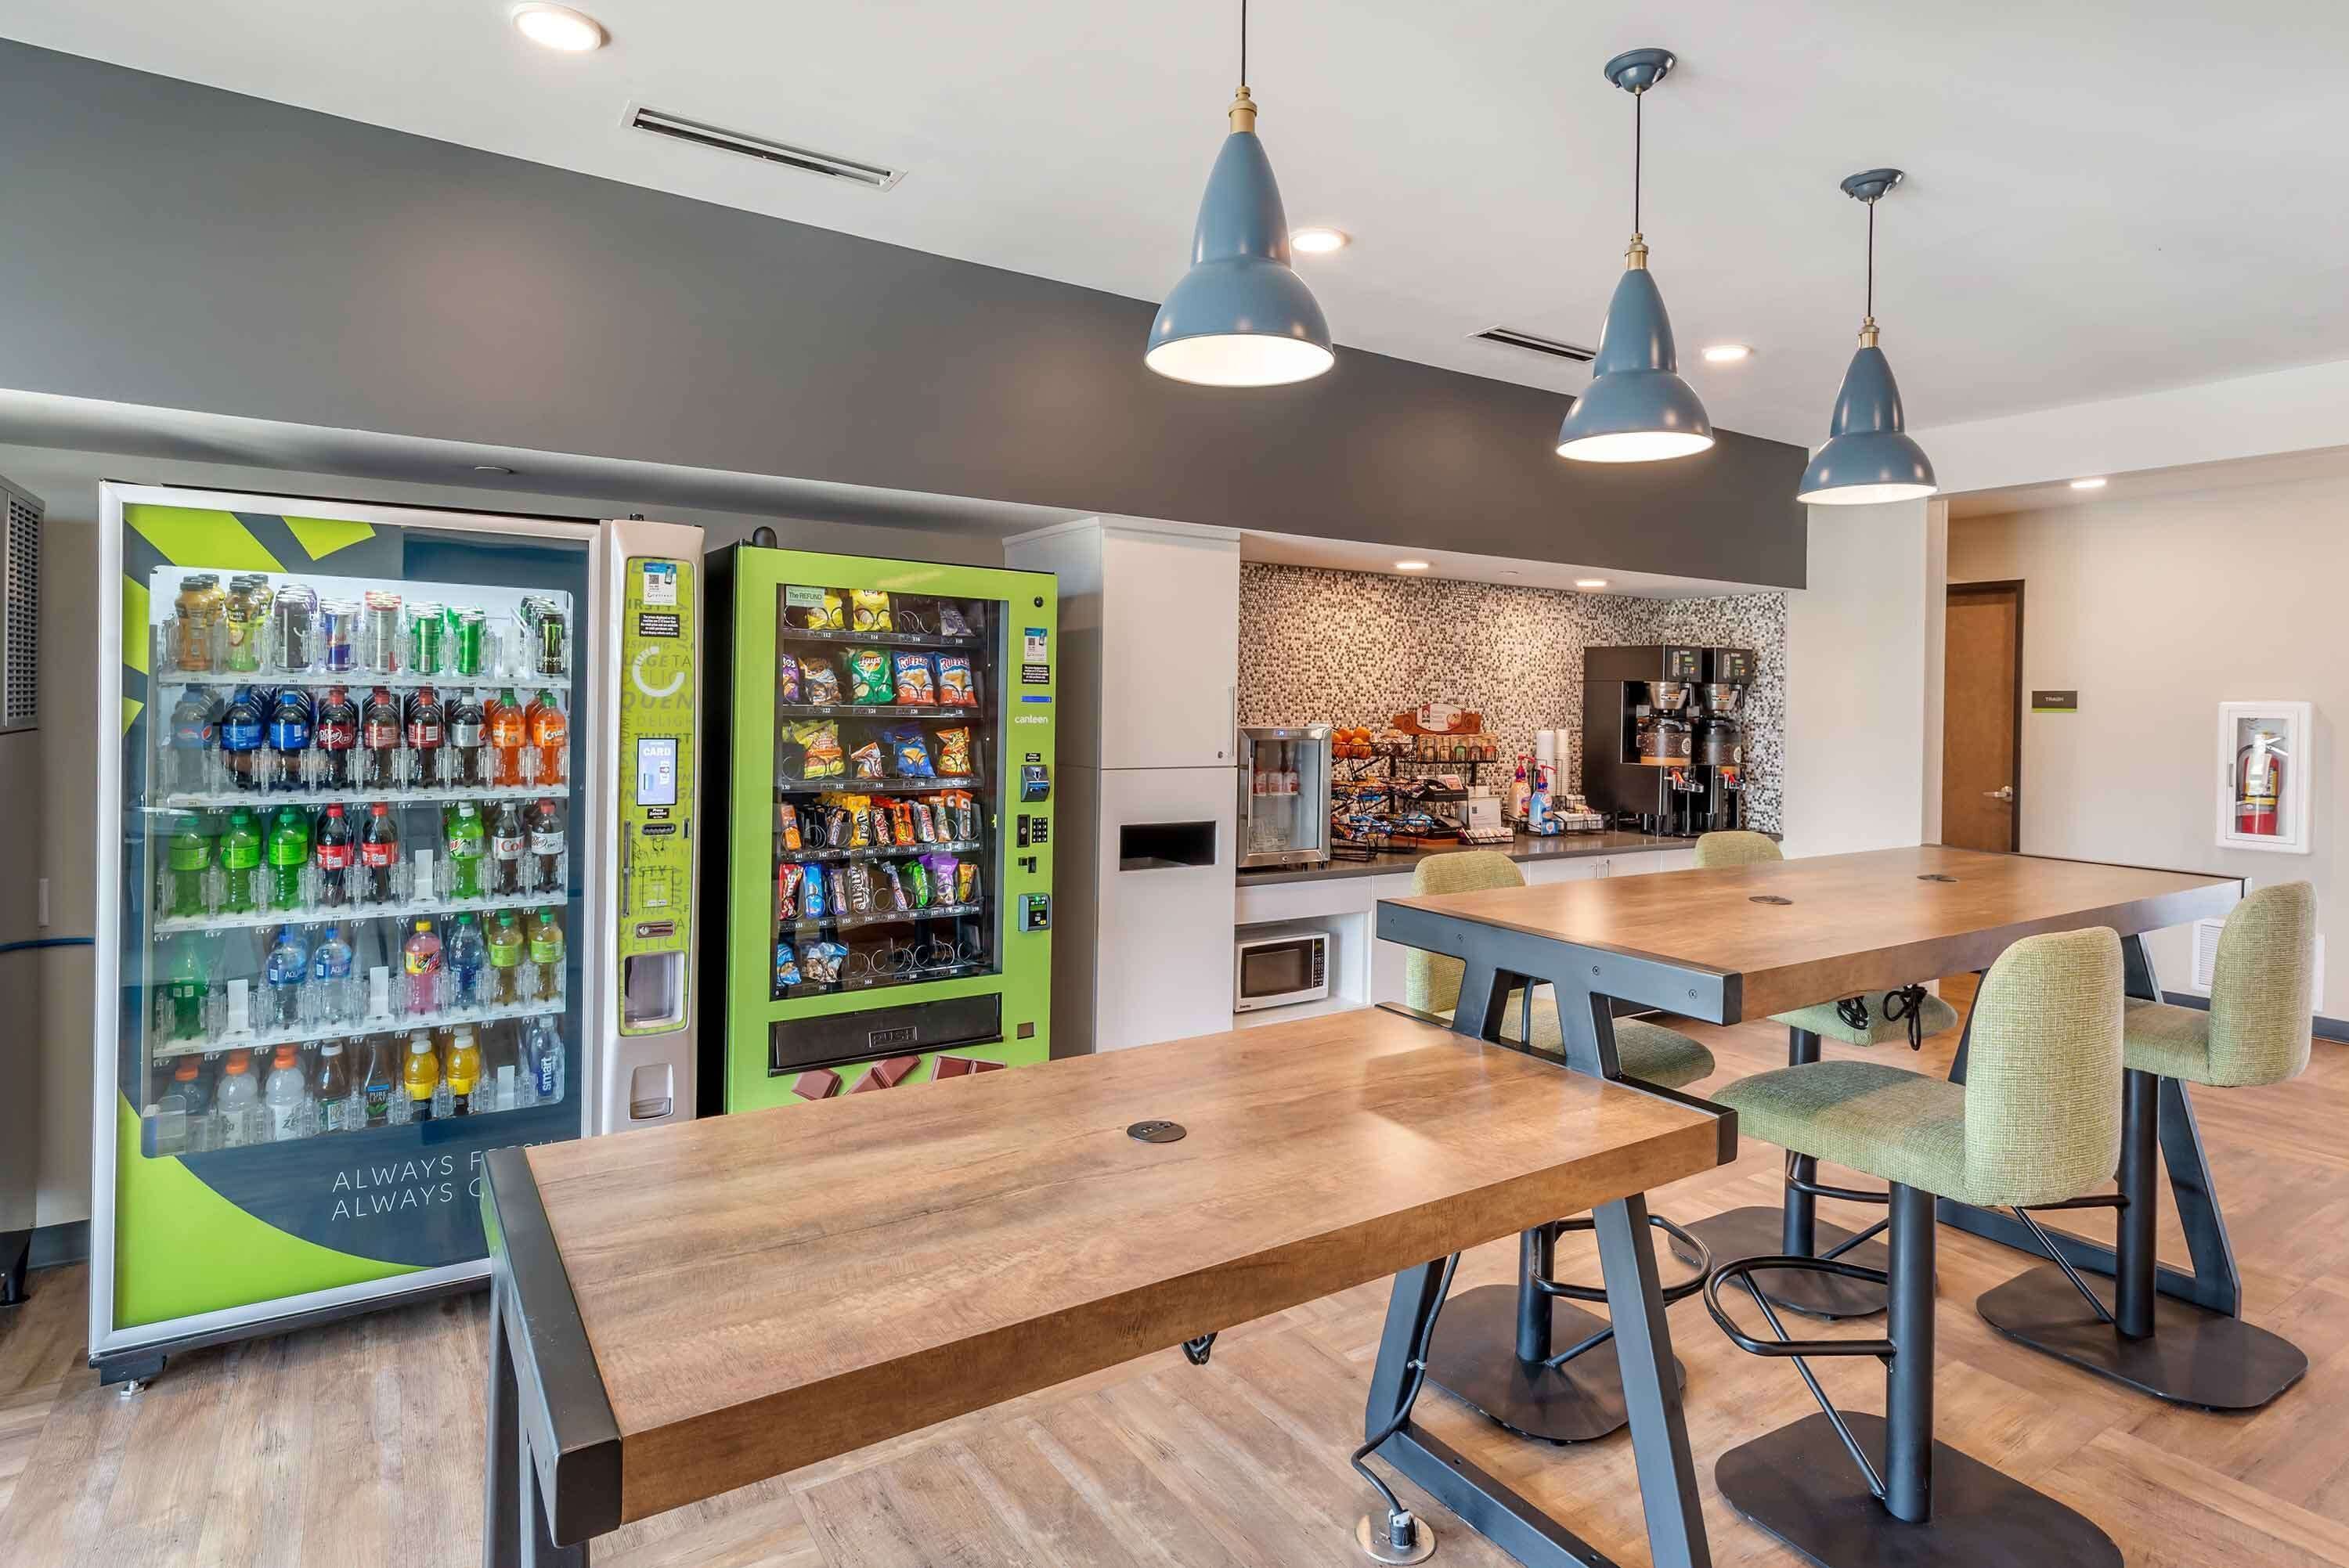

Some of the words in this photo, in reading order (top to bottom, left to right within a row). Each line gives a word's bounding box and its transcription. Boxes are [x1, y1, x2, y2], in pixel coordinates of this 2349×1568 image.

[799, 592, 822, 600] REFUND
[643, 746, 672, 757] CARD
[542, 1056, 553, 1091] smart
[332, 1155, 453, 1193] ALWAYS
[331, 1182, 453, 1221] ALWAYS
